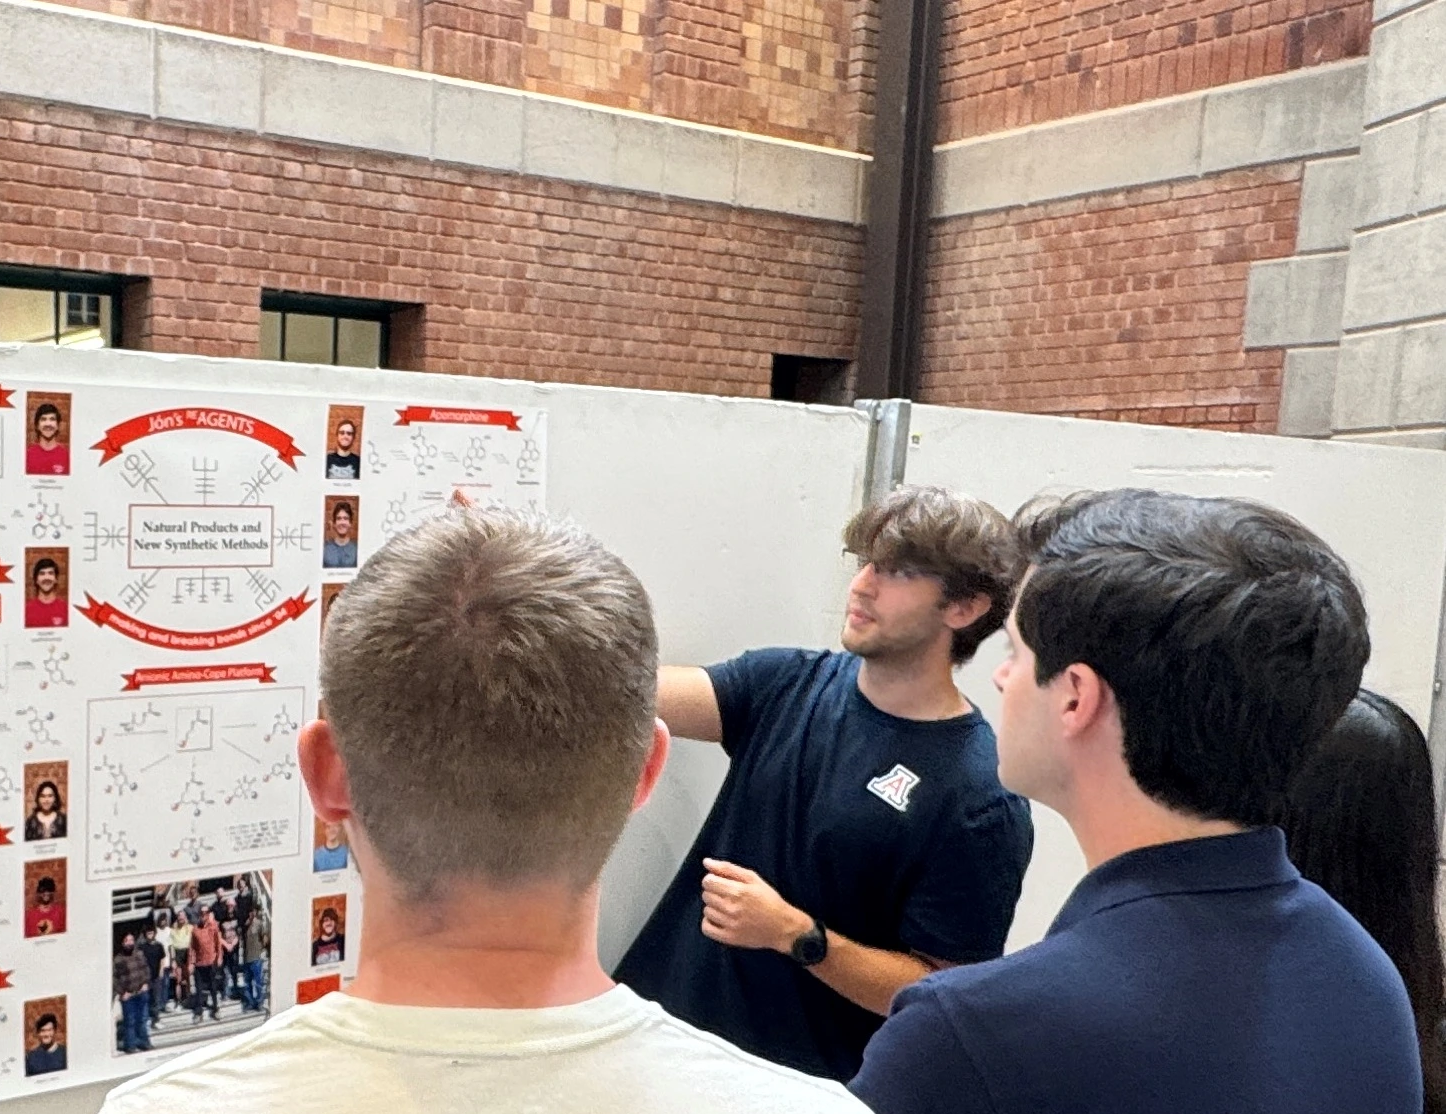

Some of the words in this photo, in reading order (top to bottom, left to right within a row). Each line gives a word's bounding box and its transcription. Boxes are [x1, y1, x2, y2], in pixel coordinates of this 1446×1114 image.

[147, 412, 184, 433] Jón's
[142, 521, 187, 533] Natural
[190, 521, 239, 533] Products
[241, 521, 261, 533] and
[134, 538, 162, 550] New
[164, 538, 218, 554] Synthetic
[221, 538, 269, 550] Methods
[147, 631, 170, 644] and
